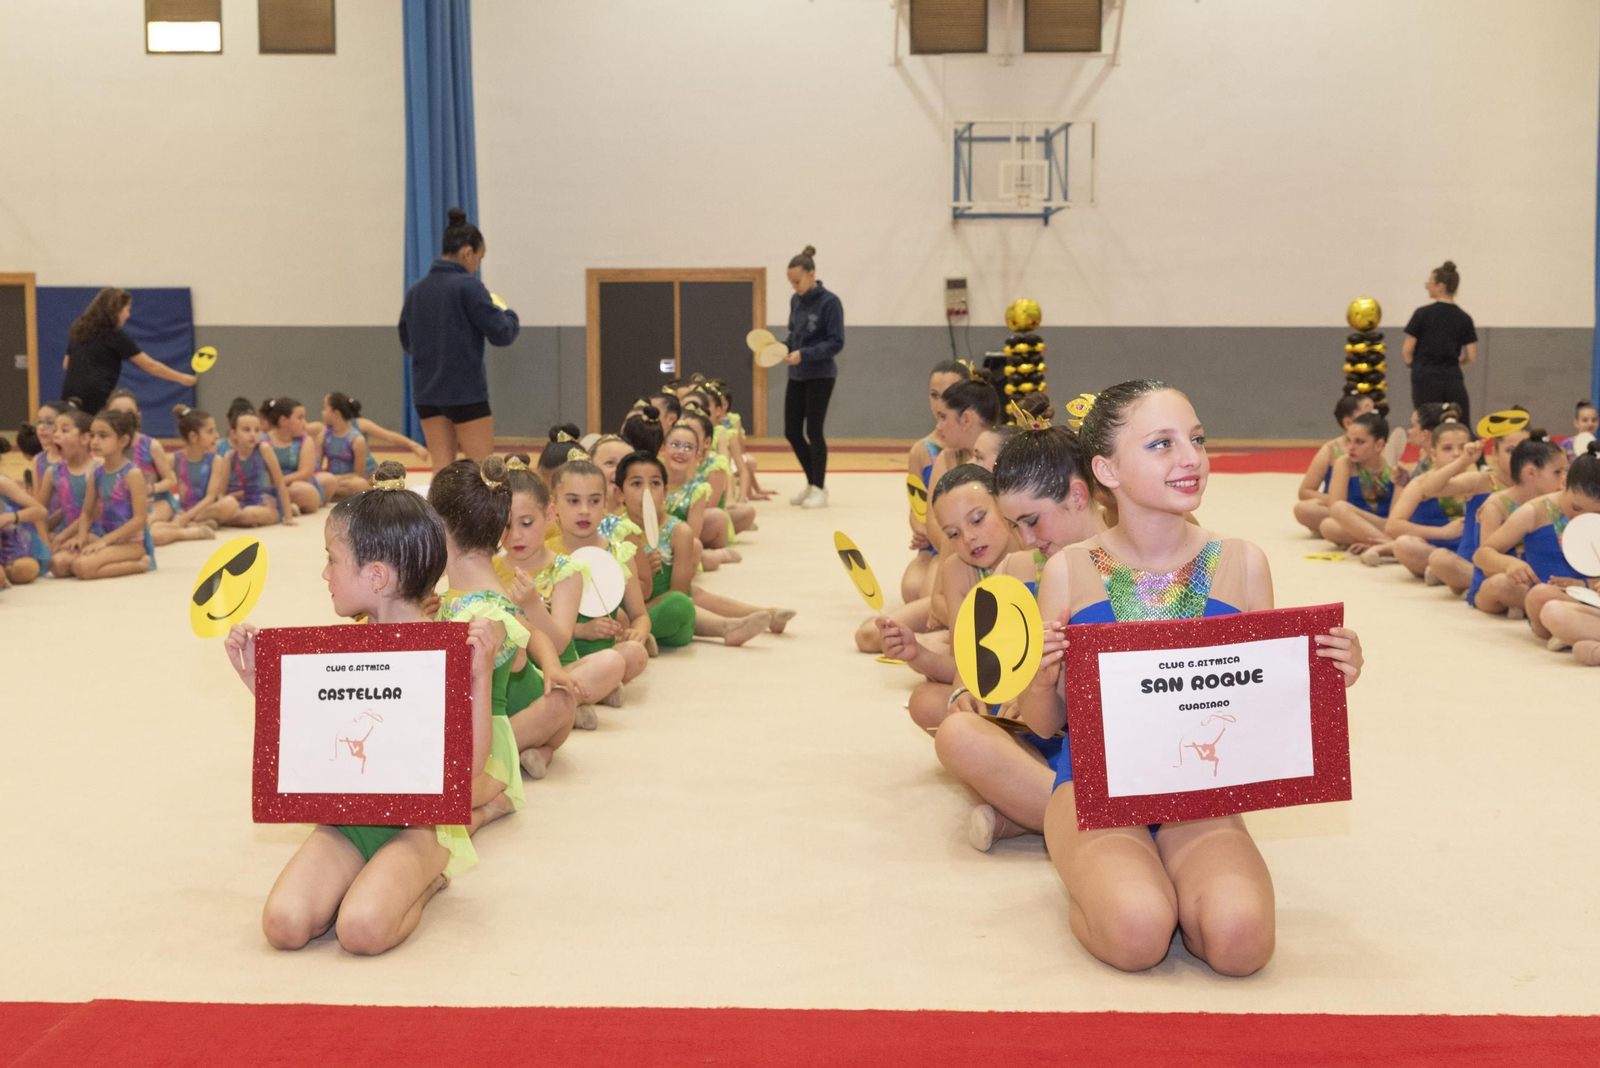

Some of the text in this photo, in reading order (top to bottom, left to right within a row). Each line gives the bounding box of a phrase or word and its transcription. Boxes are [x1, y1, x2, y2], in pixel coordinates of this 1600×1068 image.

[1158, 661, 1186, 670] CLUB
[1140, 668, 1264, 694] SAN ROQUE
[318, 687, 402, 700] CASTELLAR
[1178, 699, 1230, 712] GUADIARO
